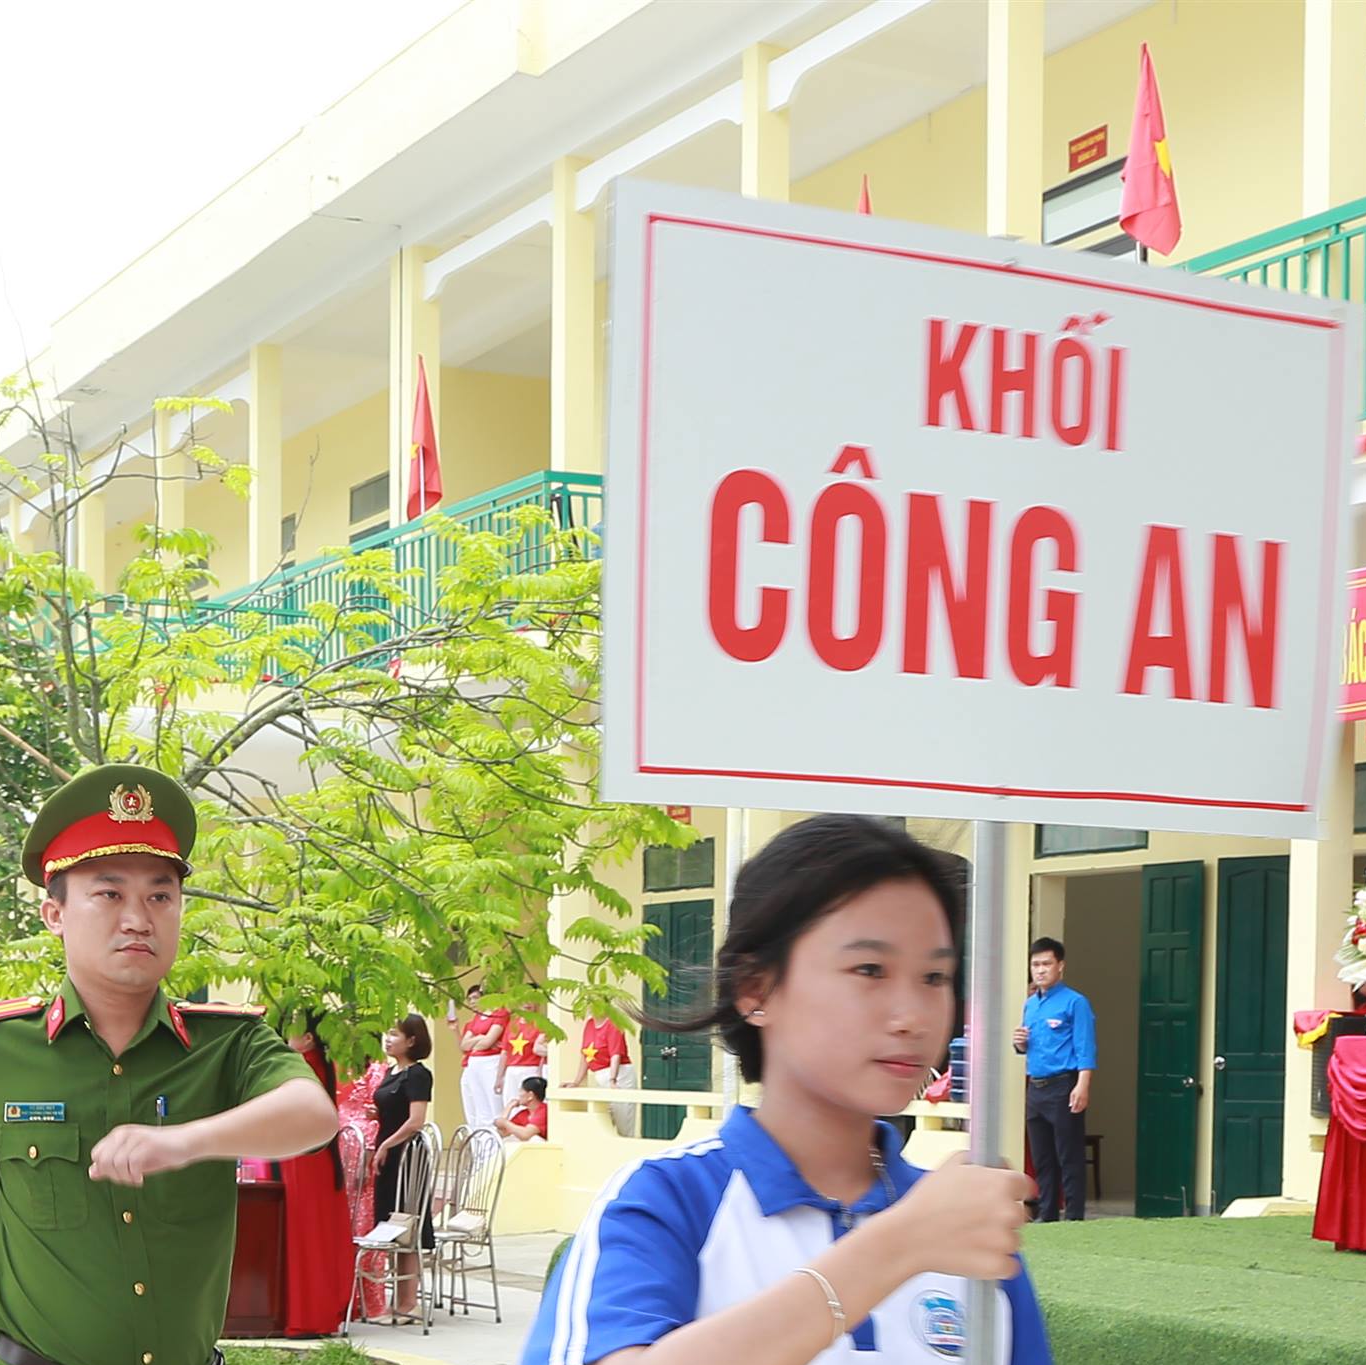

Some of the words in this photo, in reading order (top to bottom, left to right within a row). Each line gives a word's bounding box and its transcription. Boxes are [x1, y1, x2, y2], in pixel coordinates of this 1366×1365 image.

[921, 311, 1131, 453] KHỐI
[705, 443, 1083, 690] CÔNG
[1118, 521, 1289, 711] AN
